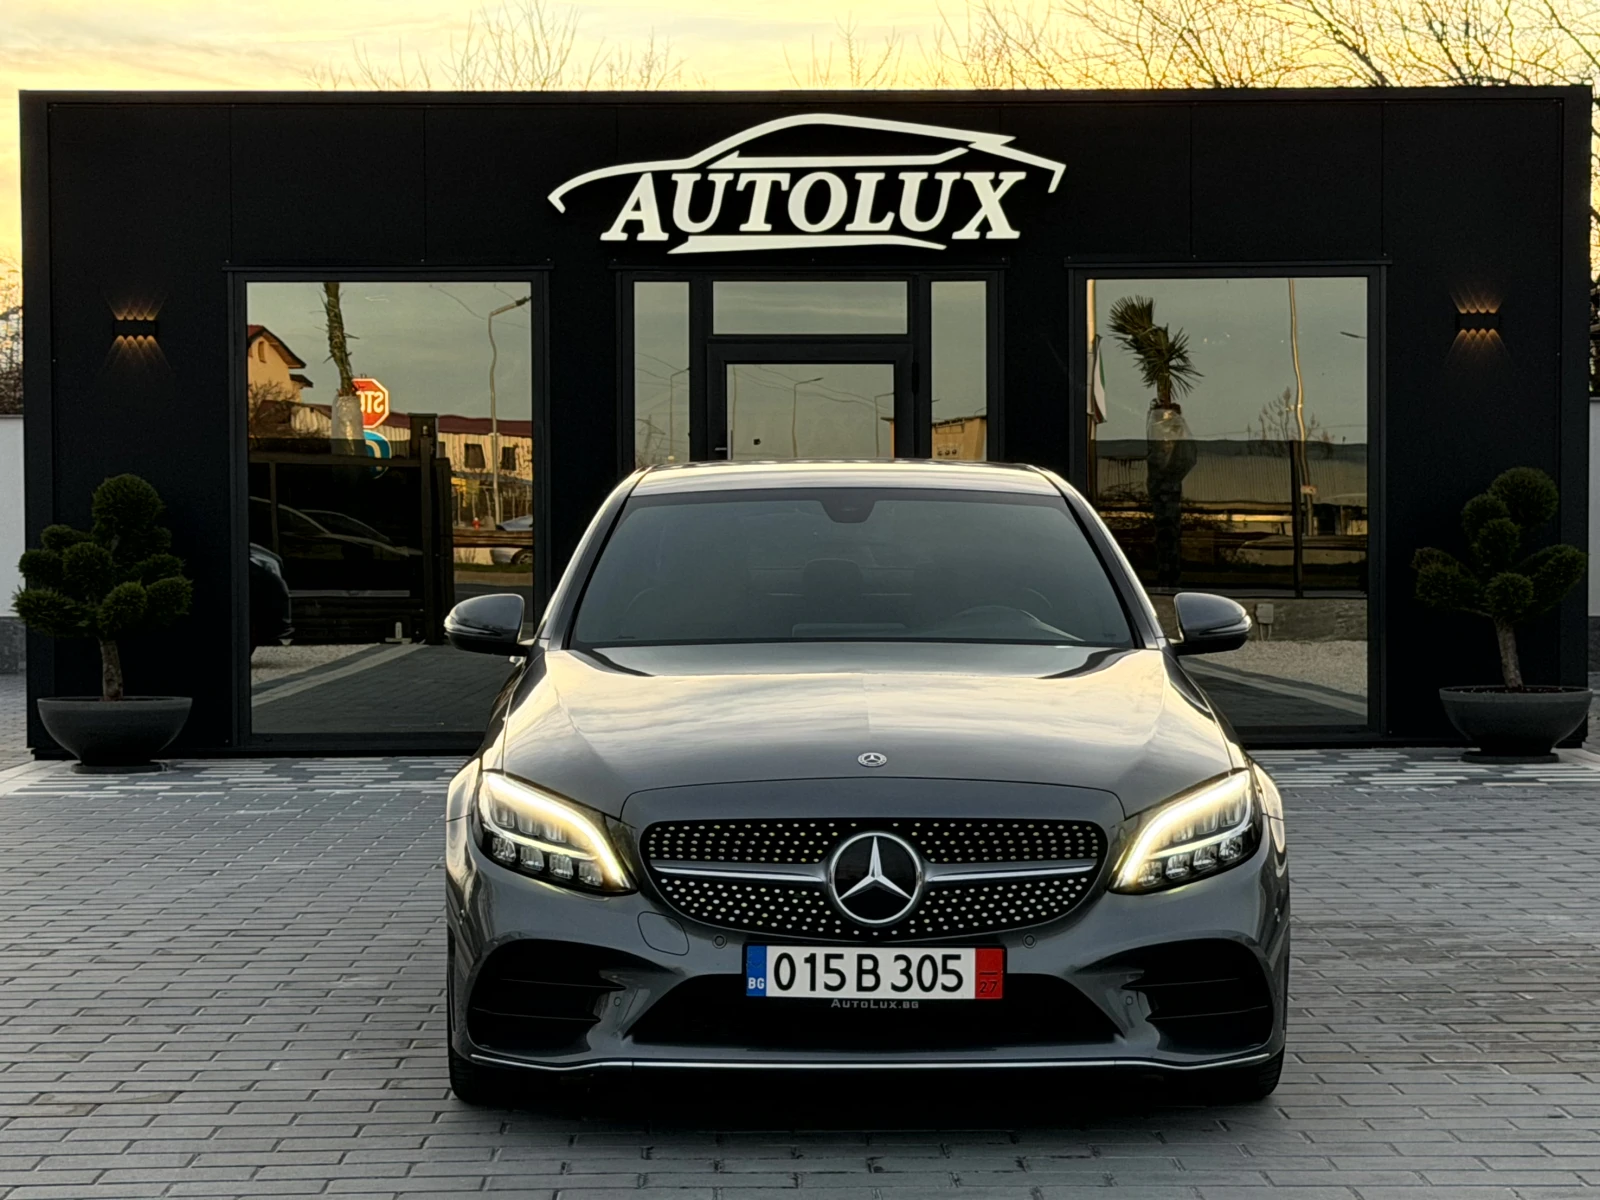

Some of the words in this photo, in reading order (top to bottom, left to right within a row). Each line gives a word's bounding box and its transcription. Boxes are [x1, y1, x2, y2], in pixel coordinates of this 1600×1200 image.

[599, 171, 1027, 242] AUTOLUX
[747, 977, 765, 990] BG
[979, 981, 998, 994] 27
